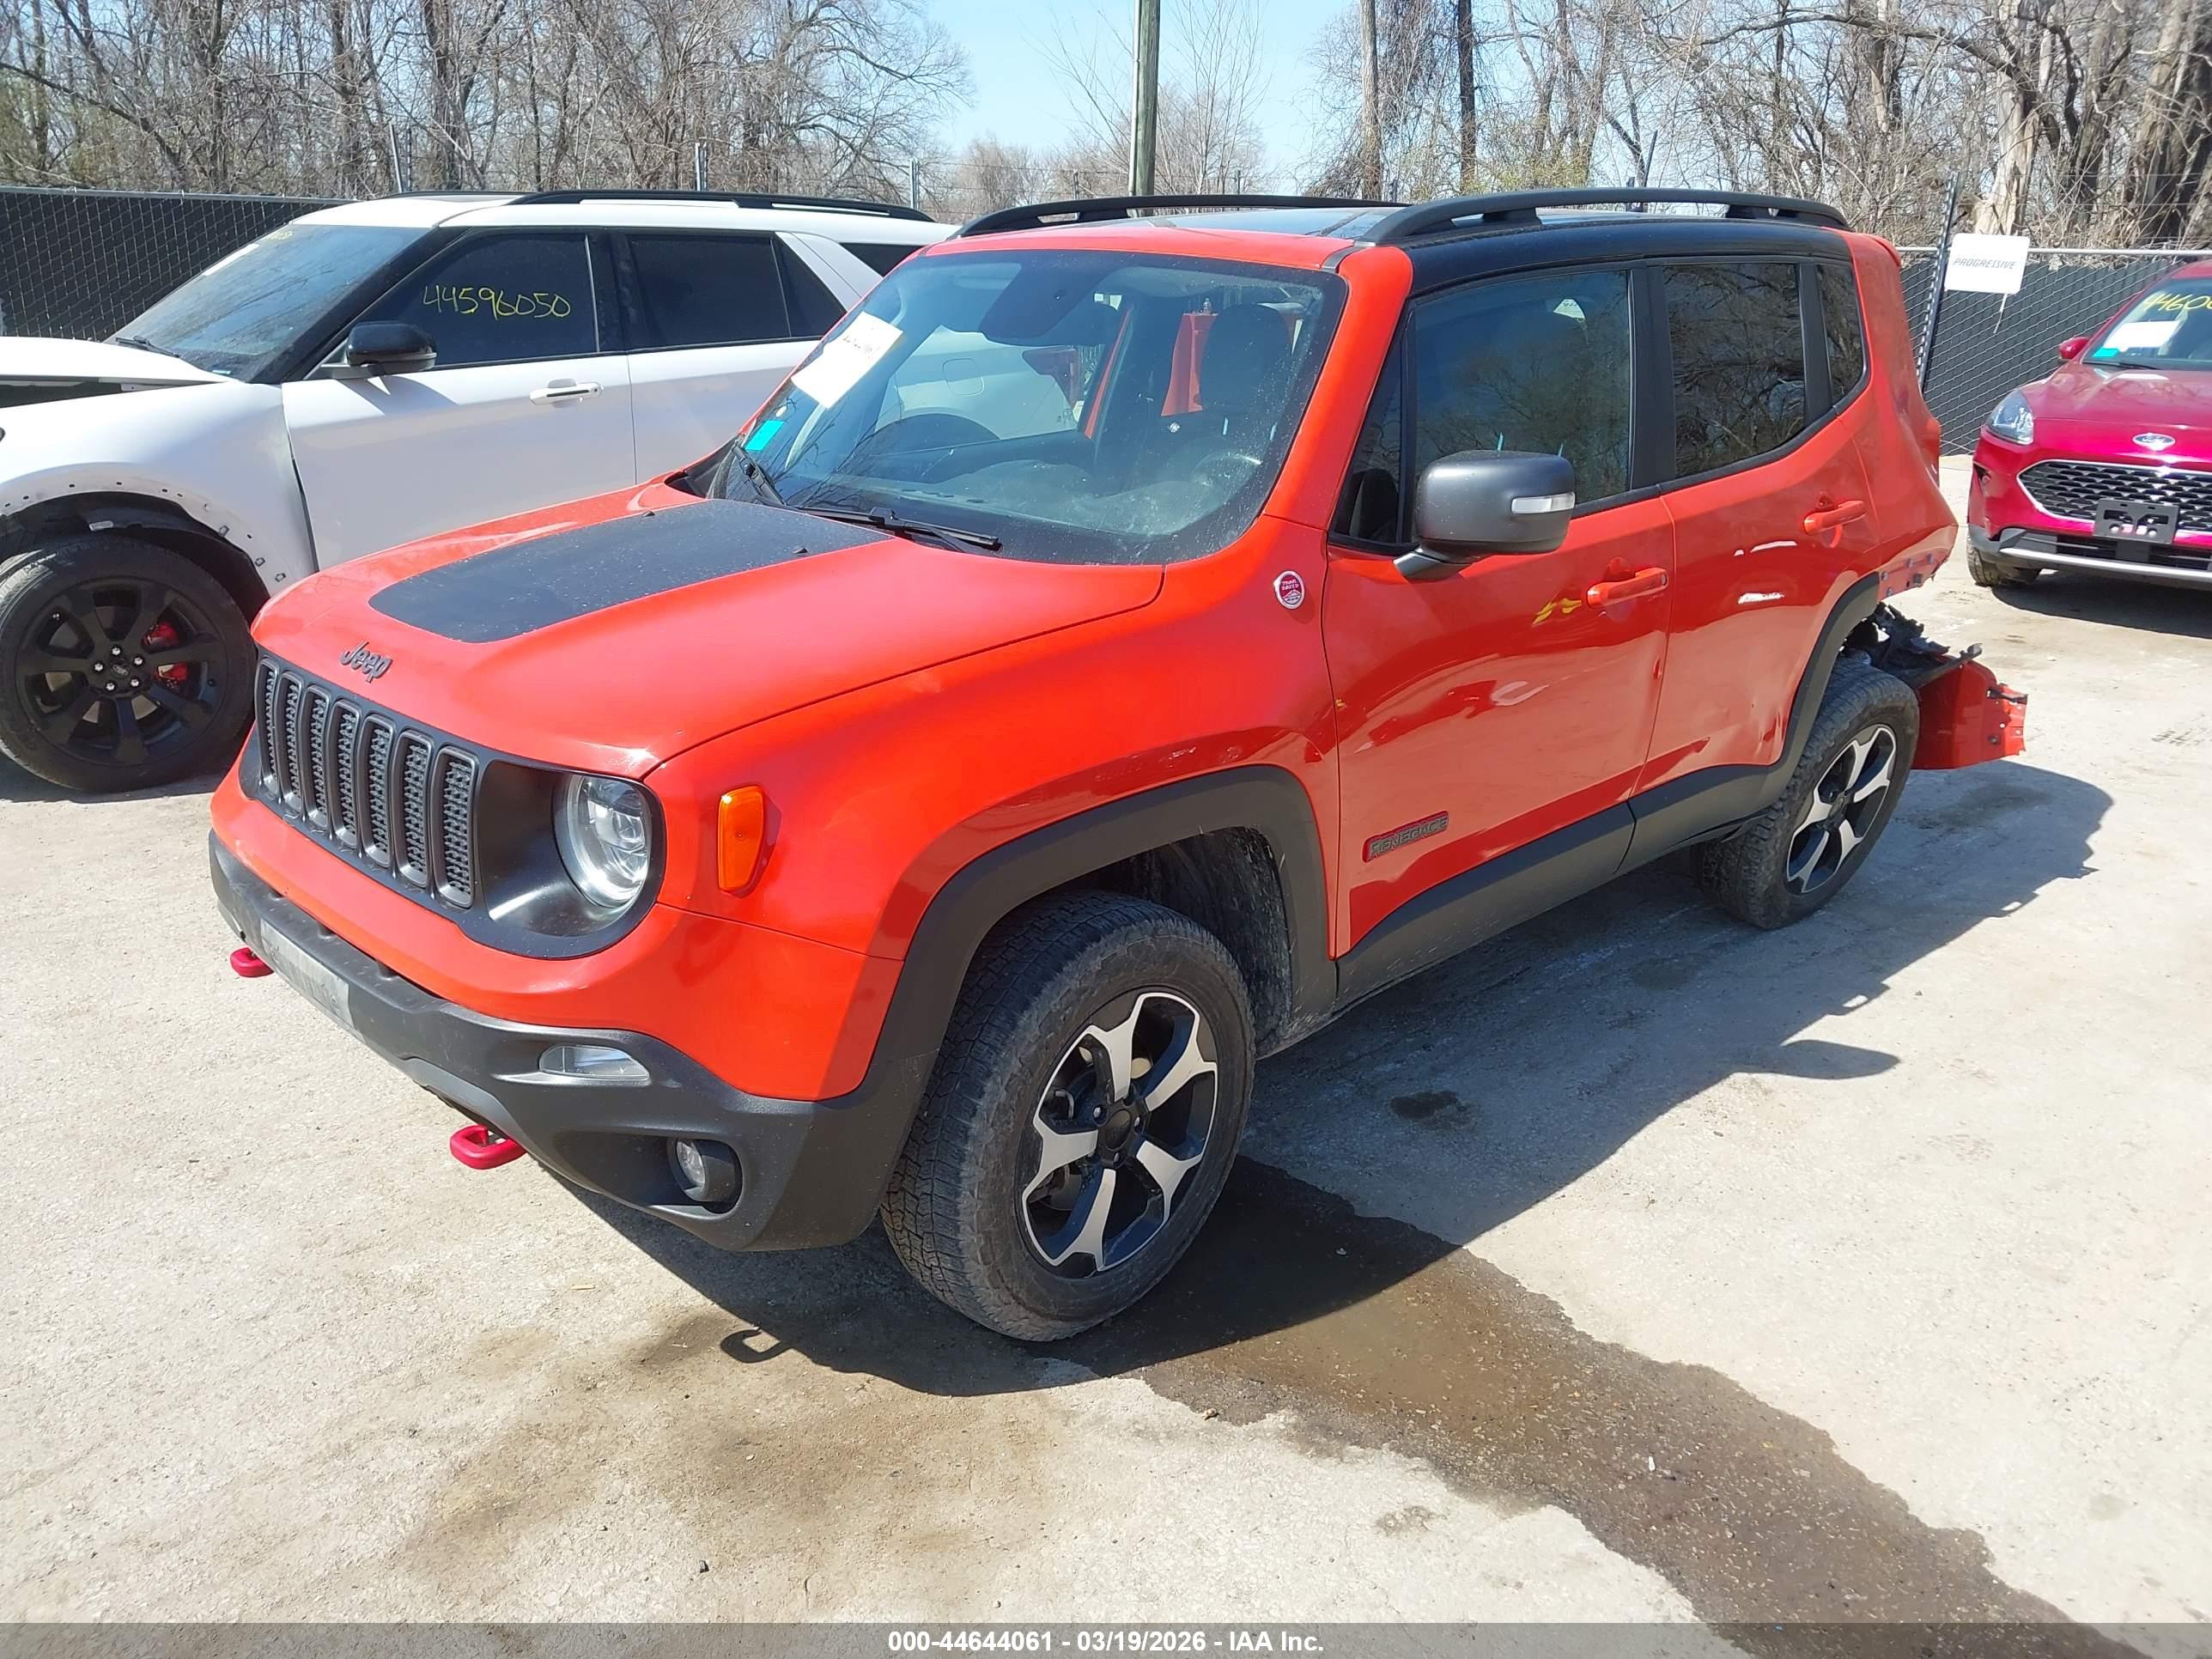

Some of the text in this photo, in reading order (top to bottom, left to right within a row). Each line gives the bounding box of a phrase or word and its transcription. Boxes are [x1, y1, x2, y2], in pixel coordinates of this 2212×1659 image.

[1953, 258, 2017, 270] PROGRESSIVE
[422, 284, 571, 320] 44596050
[340, 641, 393, 684] Jeep
[1369, 815, 1449, 860] RENEGADE
